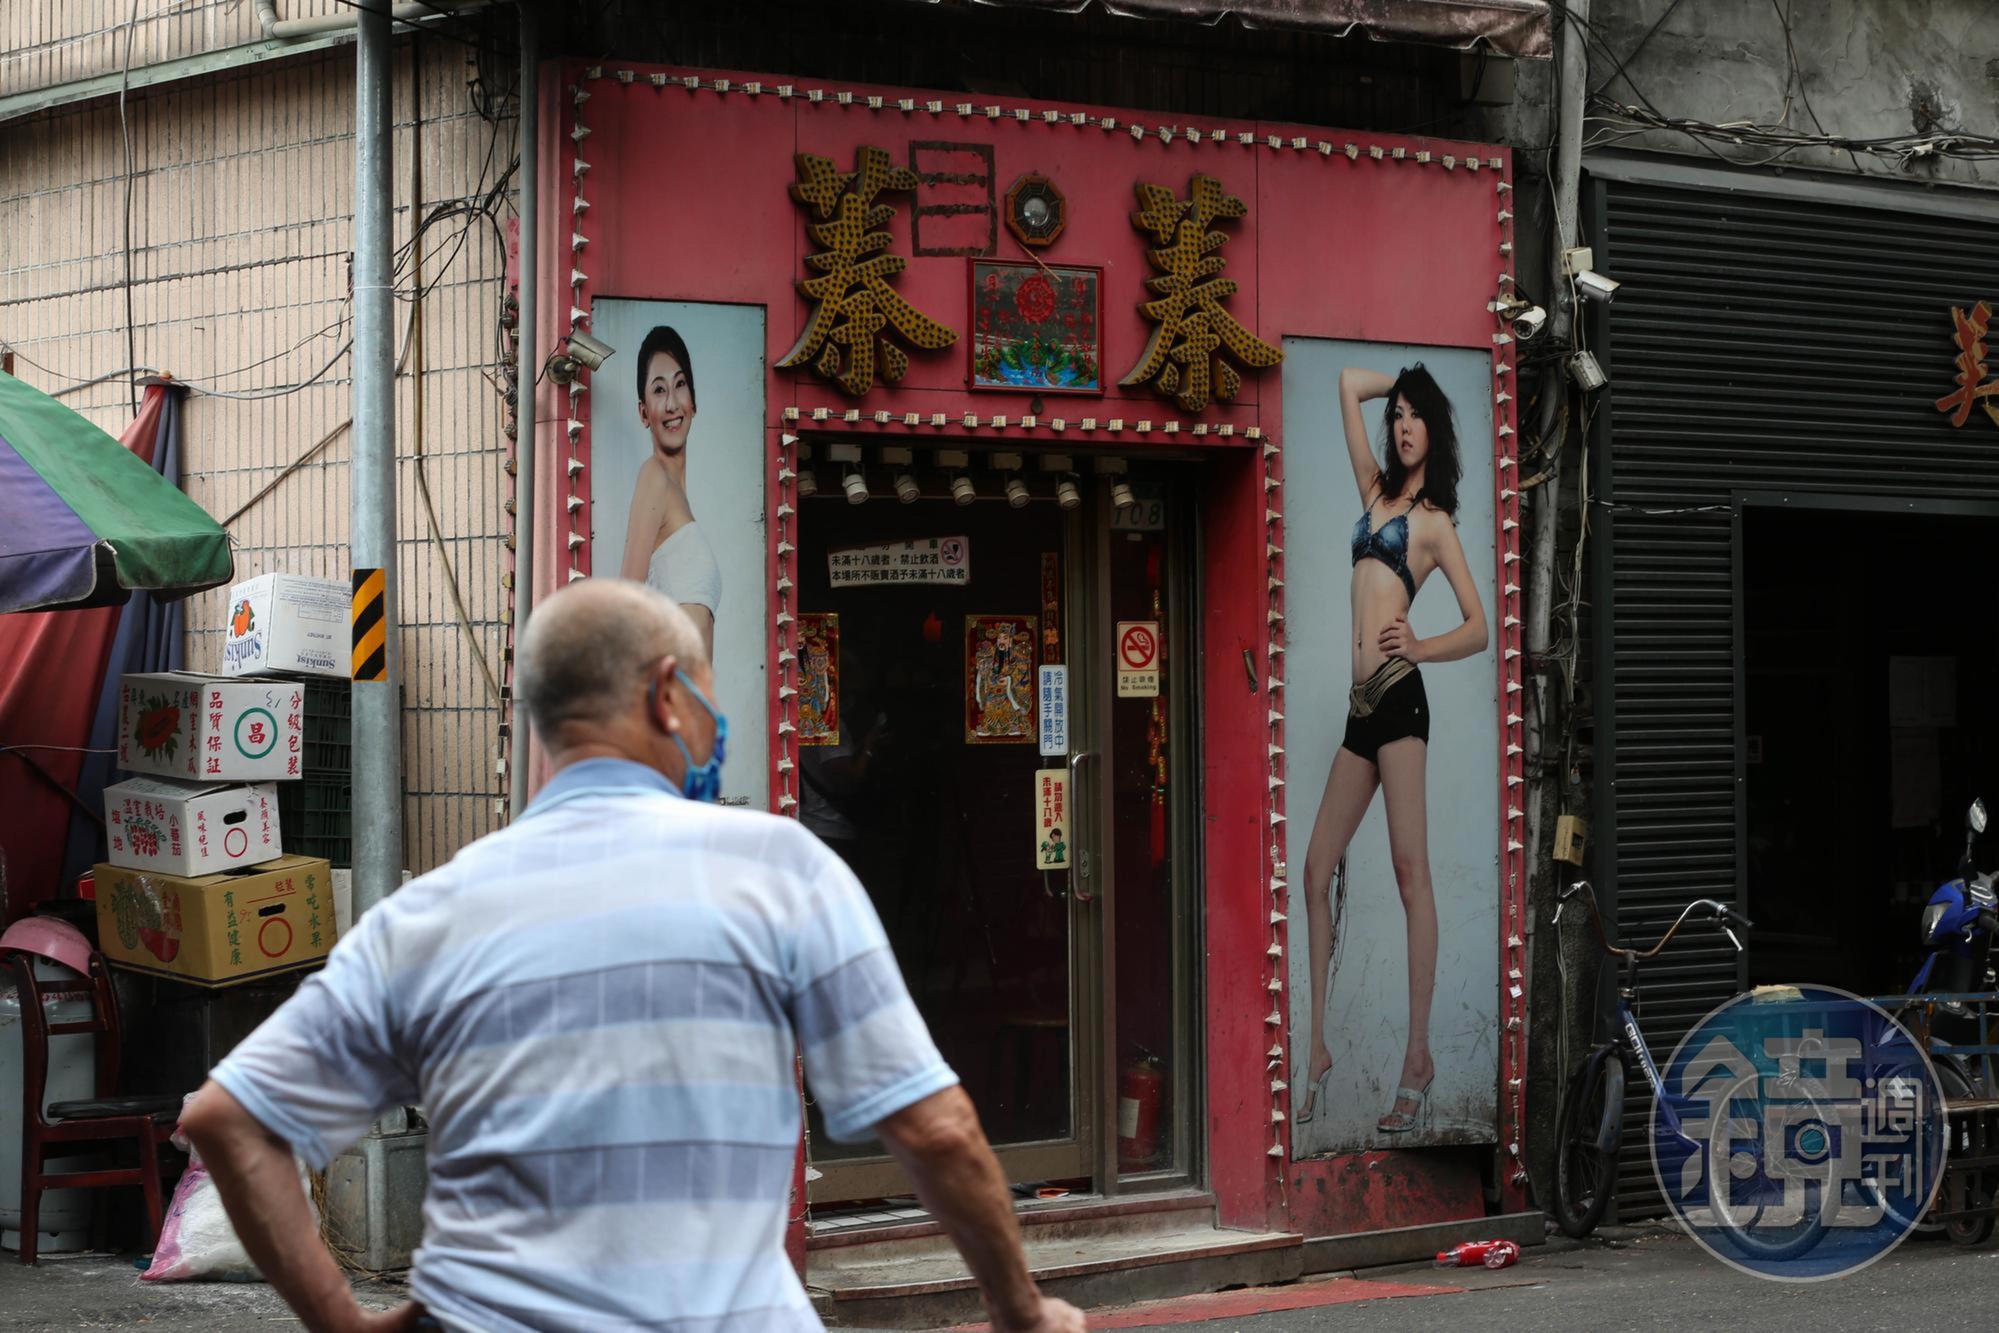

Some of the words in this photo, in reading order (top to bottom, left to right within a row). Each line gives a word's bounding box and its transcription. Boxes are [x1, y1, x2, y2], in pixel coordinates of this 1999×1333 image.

[296, 654, 336, 669] Sunkist
[206, 691, 223, 774] 品質保証
[248, 722, 266, 744] 昌
[287, 691, 302, 775] 分級包裝
[1054, 671, 1064, 749] 冷氣開放中
[1054, 782, 1063, 823] 請勿進入
[223, 891, 242, 966] 有益健康
[304, 874, 322, 948] 常吃水果
